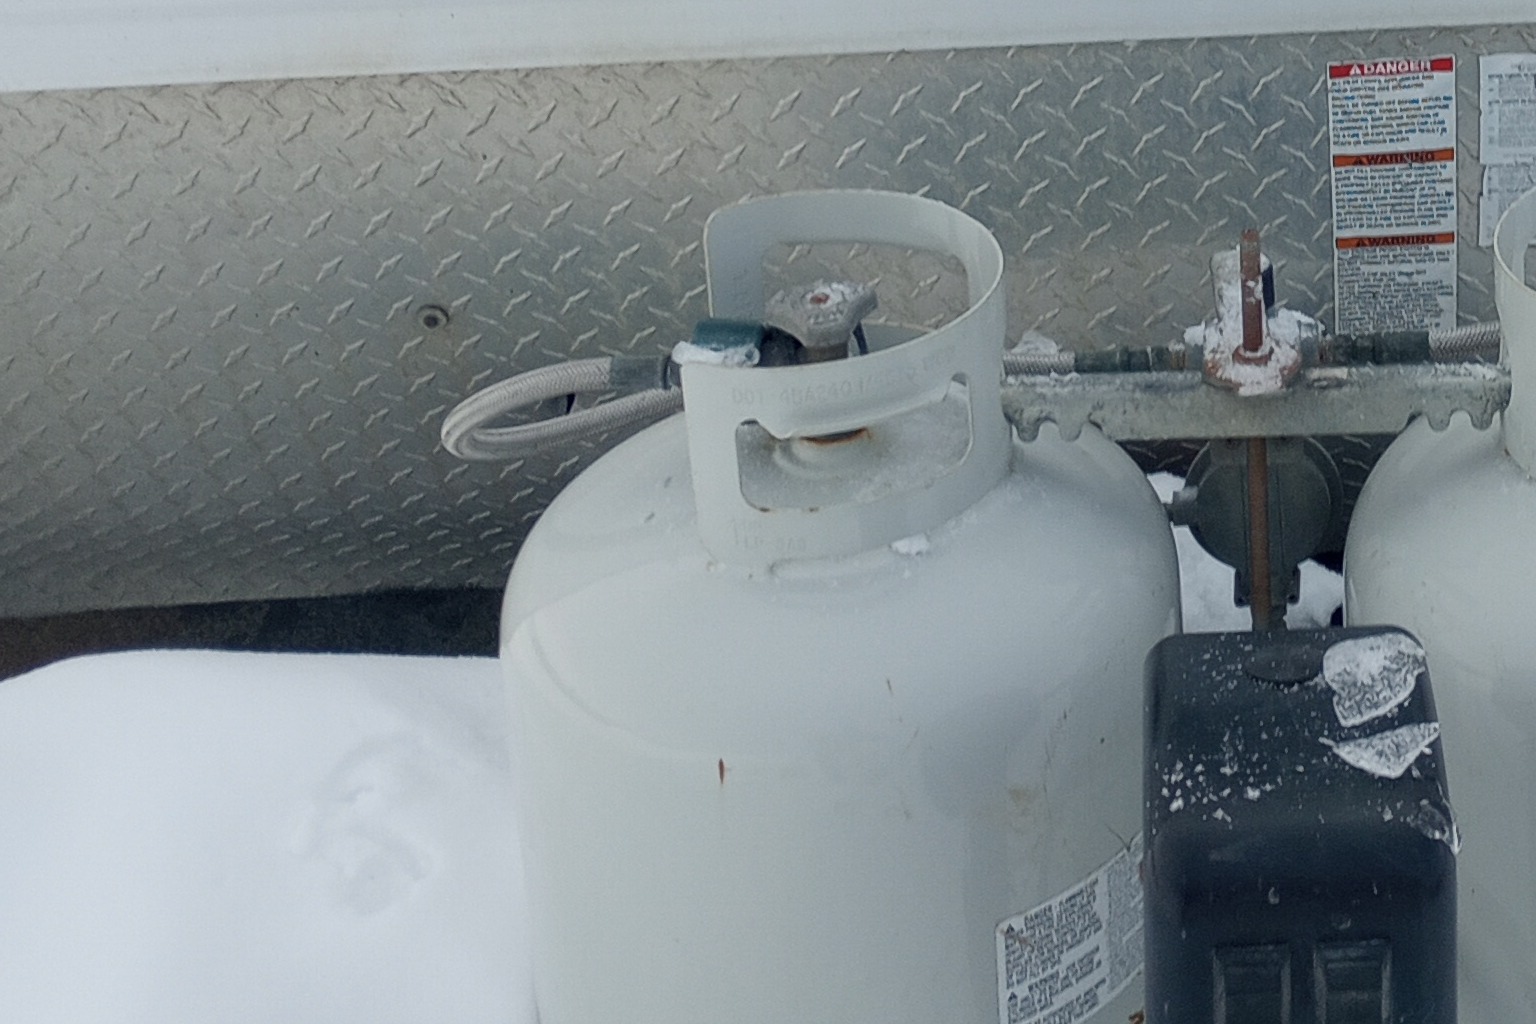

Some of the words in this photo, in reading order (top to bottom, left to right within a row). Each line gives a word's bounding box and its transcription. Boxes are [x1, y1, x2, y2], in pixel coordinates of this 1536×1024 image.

[1363, 60, 1431, 77] DANGER
[1368, 151, 1435, 166] WARNING
[1369, 234, 1436, 248] WARNING
